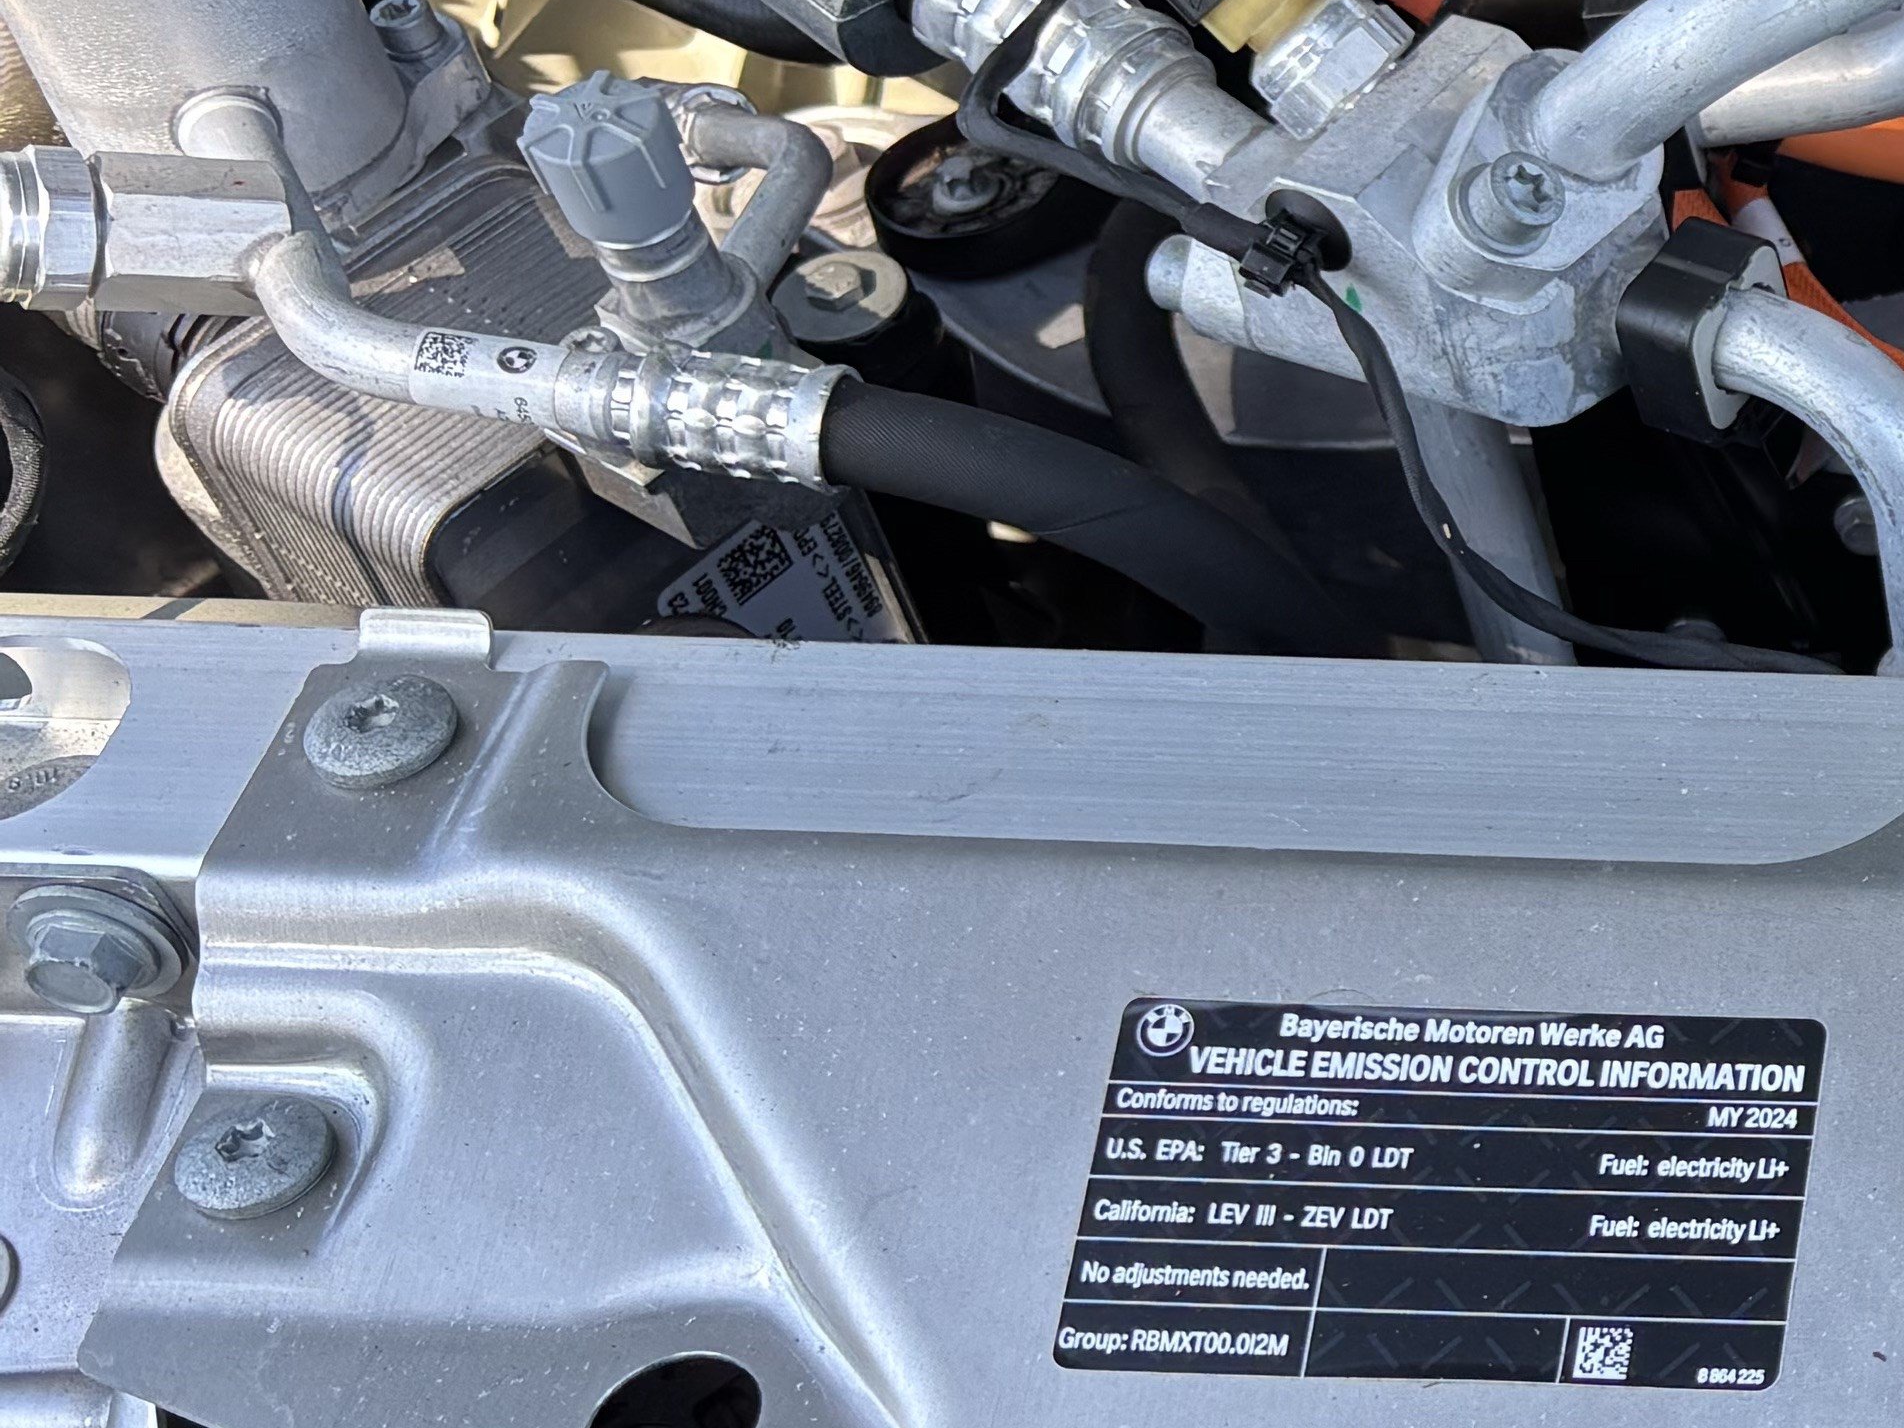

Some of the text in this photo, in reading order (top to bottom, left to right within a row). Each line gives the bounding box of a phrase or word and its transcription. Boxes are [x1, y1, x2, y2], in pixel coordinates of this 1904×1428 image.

[1279, 1012, 1666, 1050] Bayerische Motoren Werke AG
[1188, 1045, 1807, 1094] VEHICLE EMISSION CONTROL INFORMATION
[1116, 1086, 1360, 1118] Conforms to regulations:
[1707, 1106, 1799, 1130] MY 2024
[1106, 1138, 1148, 1162] U.S.
[1154, 1138, 1206, 1163] EPA:
[1220, 1140, 1261, 1164] Tier
[1265, 1143, 1284, 1165] 3
[1307, 1143, 1341, 1167] Bin
[1370, 1146, 1415, 1170] LDT
[1598, 1153, 1791, 1183] Fuel: electricity Li+
[1093, 1198, 1197, 1224] California:
[1206, 1202, 1250, 1226] LEV
[1254, 1204, 1277, 1227] III
[1300, 1206, 1347, 1230] ZEV
[1349, 1206, 1396, 1231] LDT
[1588, 1214, 1781, 1245] Fuel: electricity Li+
[1080, 1260, 1311, 1291] No adjustments needed.
[1058, 1326, 1129, 1355] Group:
[1736, 1368, 1766, 1385] 225
